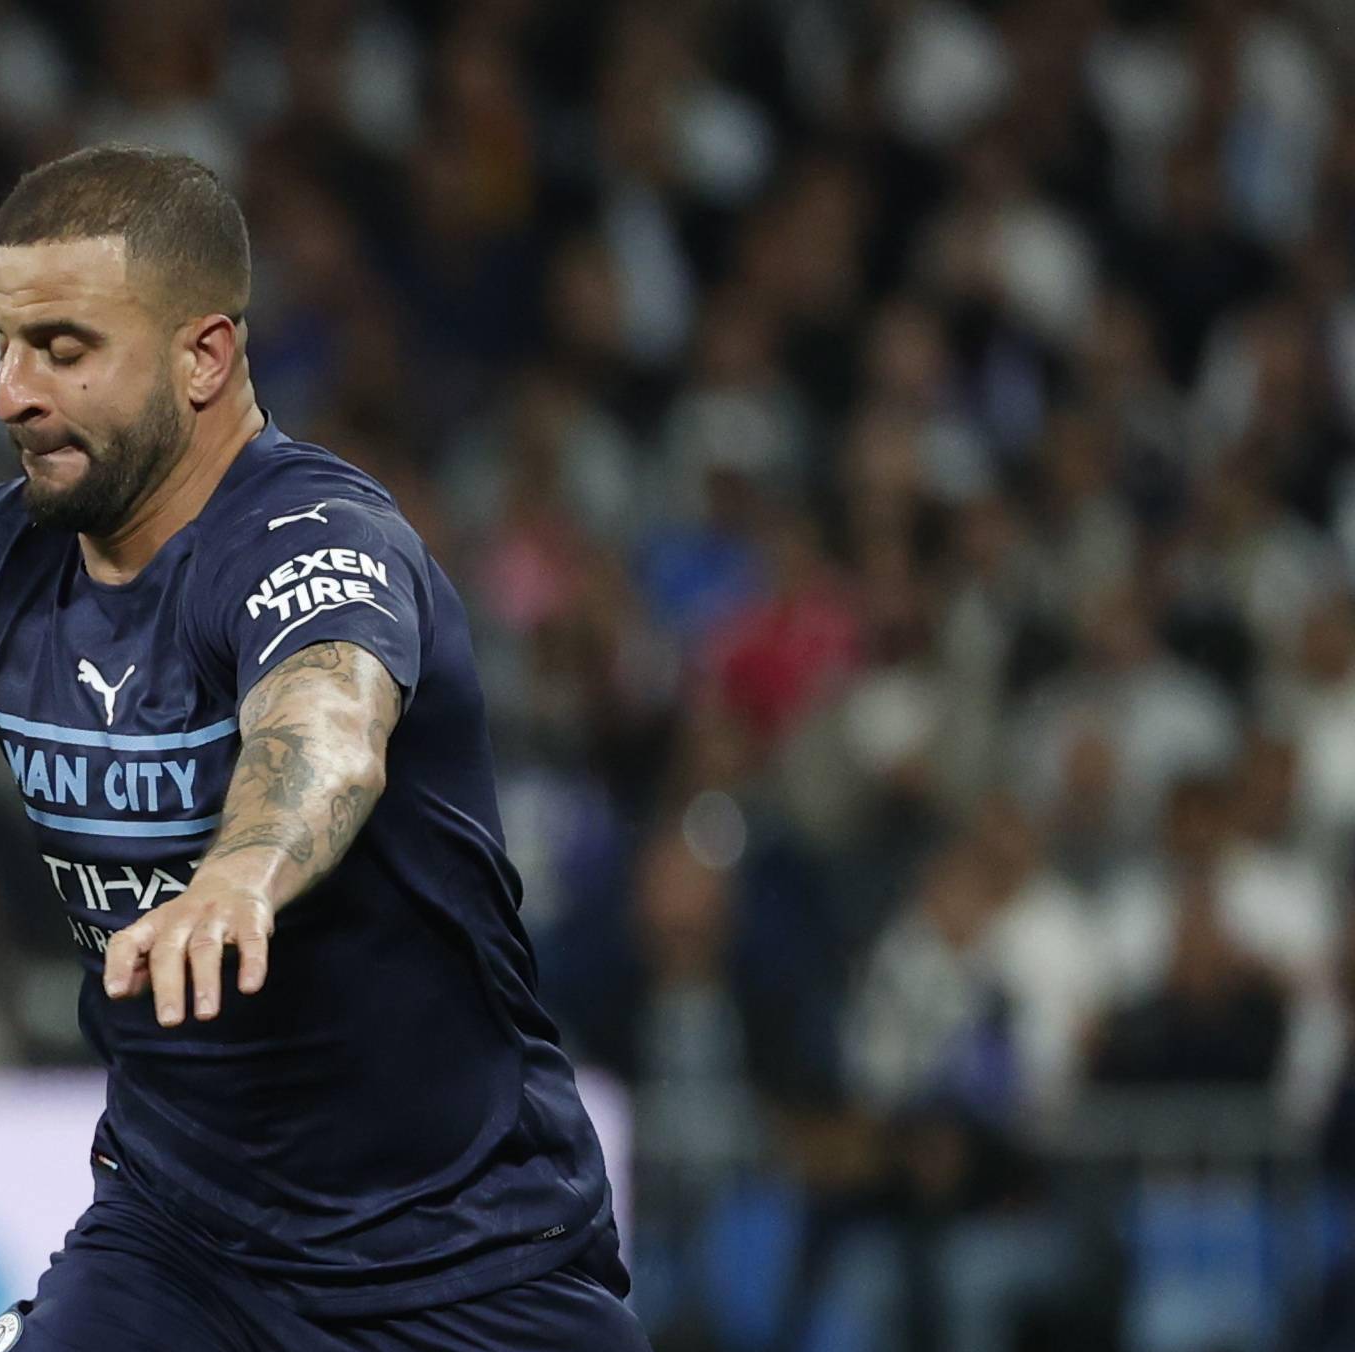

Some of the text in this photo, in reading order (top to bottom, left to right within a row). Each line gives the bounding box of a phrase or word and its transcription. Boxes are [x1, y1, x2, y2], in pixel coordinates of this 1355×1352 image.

[246, 548, 389, 620] NEXEN
[266, 576, 375, 621] TIRE
[2, 739, 197, 812] MAN CITY
[42, 854, 199, 911] TIHA
